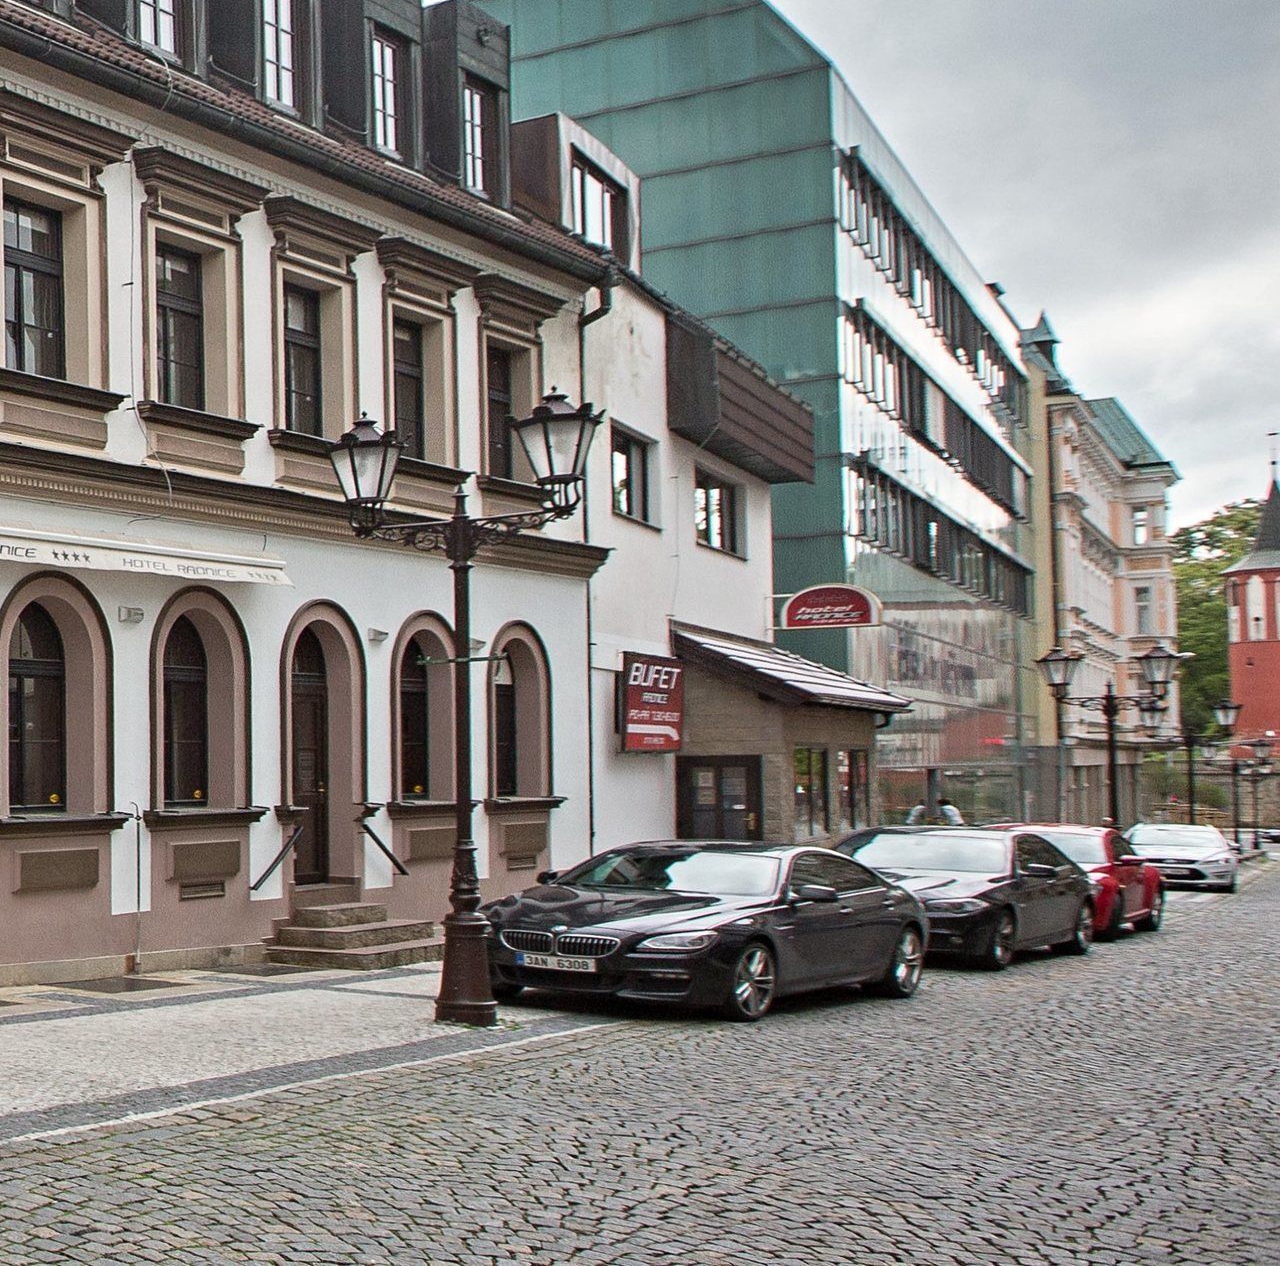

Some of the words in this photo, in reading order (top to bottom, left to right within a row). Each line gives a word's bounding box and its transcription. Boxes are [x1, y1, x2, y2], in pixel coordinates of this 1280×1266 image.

[122, 558, 171, 572] HOTEL
[177, 564, 238, 578] RADNICE
[796, 604, 855, 614] hotel
[629, 662, 682, 690] BUFET
